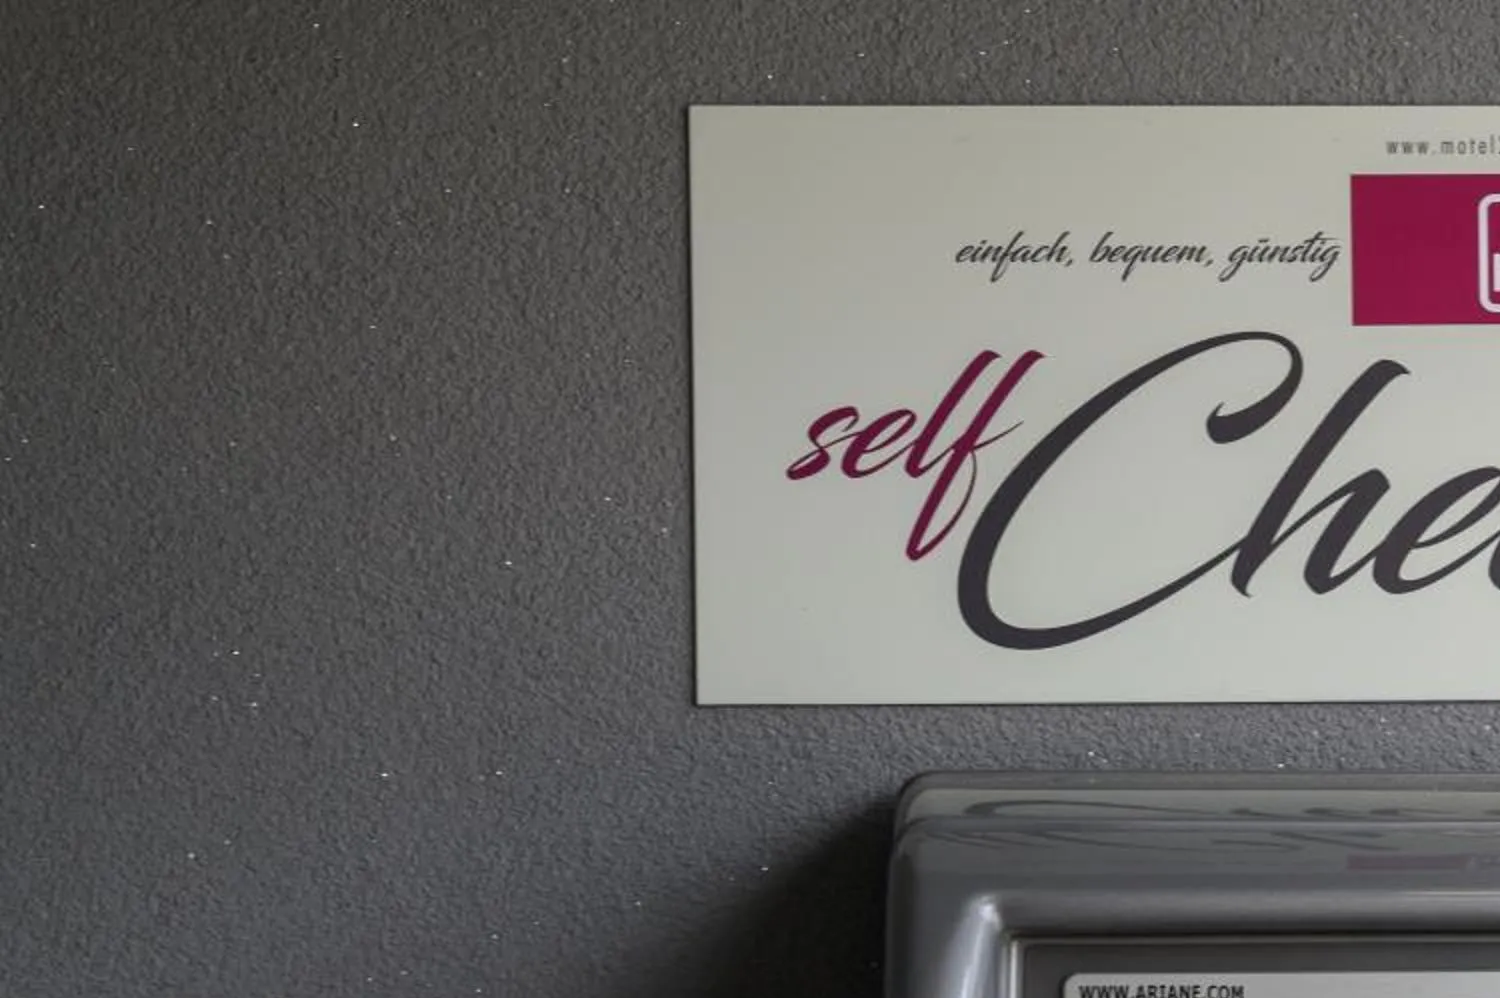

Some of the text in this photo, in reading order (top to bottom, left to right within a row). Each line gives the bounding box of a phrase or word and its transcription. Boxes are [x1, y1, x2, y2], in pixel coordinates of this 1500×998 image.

[954, 230, 1342, 284] einfach, bequem, günstig
[786, 350, 1046, 560] self
